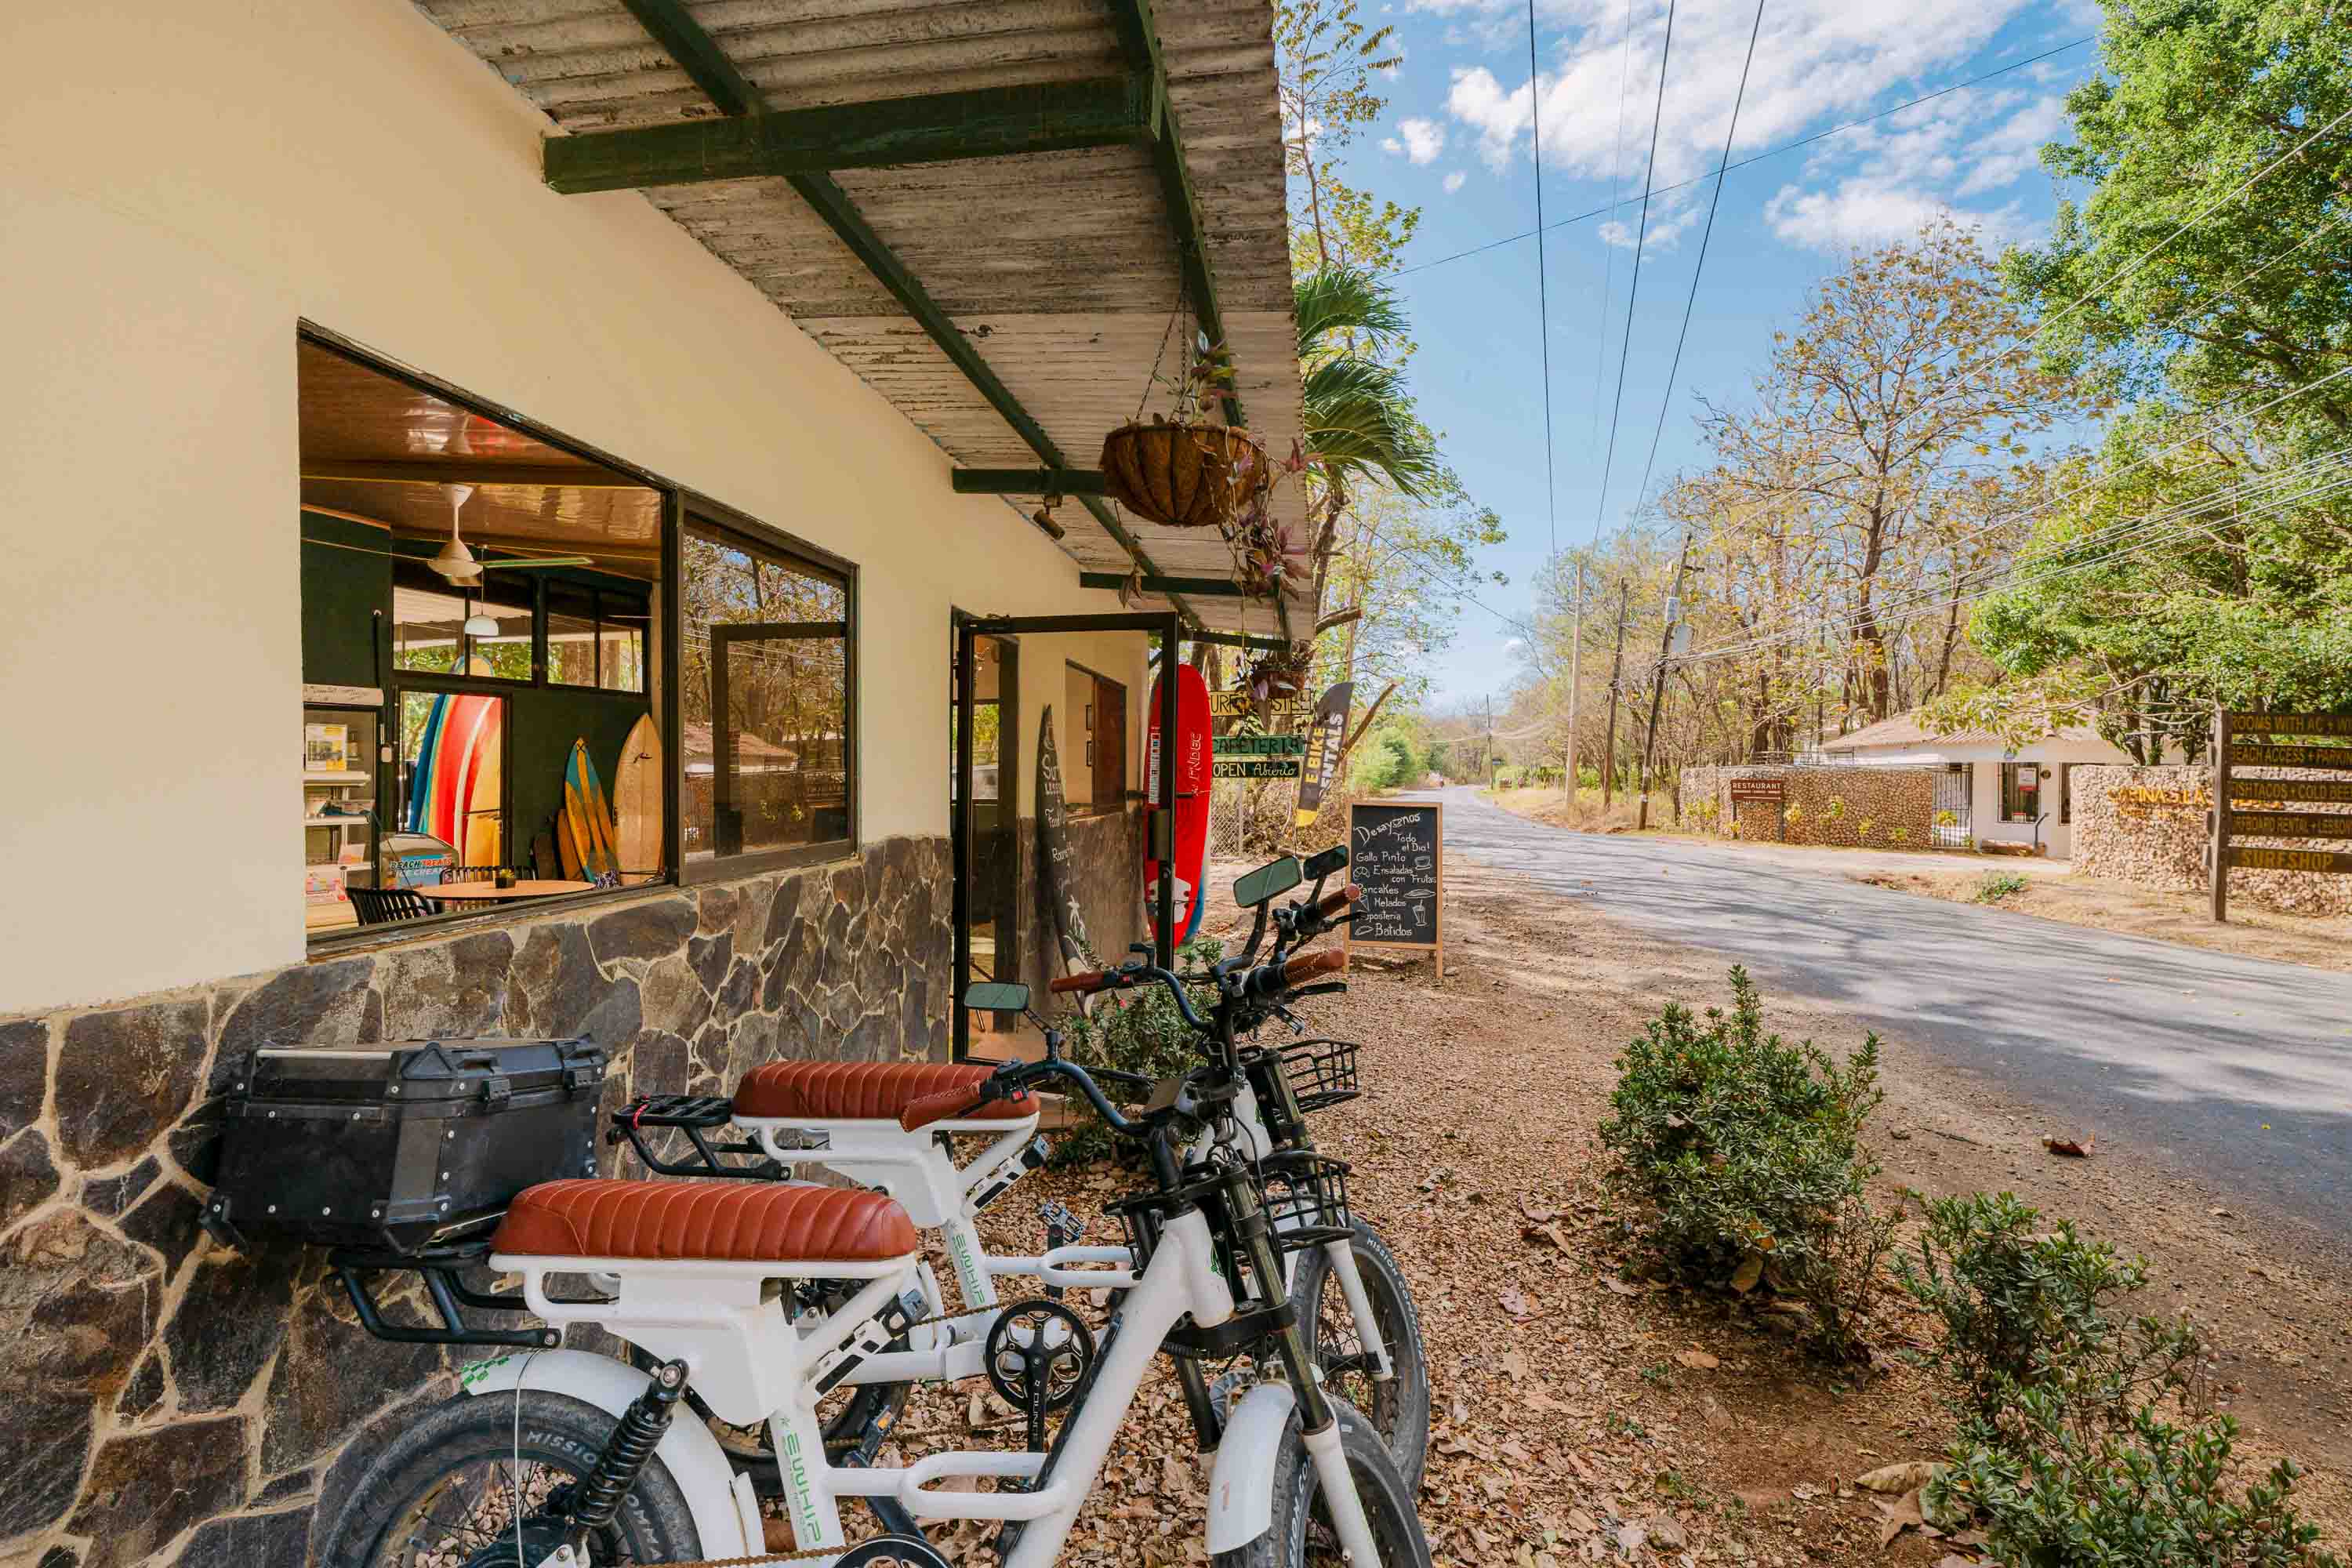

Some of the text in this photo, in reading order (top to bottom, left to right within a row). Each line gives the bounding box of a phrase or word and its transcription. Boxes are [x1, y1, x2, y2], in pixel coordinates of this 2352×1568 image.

[1307, 727, 1326, 768] BIKE
[1319, 713, 1343, 798] ENTALS
[1213, 763, 1296, 777] OPEN Abierto
[1392, 832, 1417, 843] Todo
[1356, 851, 1406, 862] Gallo Pinto
[2289, 853, 2333, 871] SHOP
[1374, 864, 1414, 875] Ensaladas
[1410, 874, 1437, 884] Frutas
[1374, 897, 1406, 908] Helados
[1374, 922, 1413, 937] Batidos
[1366, 1236, 1399, 1277] MISSION
[526, 1429, 598, 1465] MISSIO
